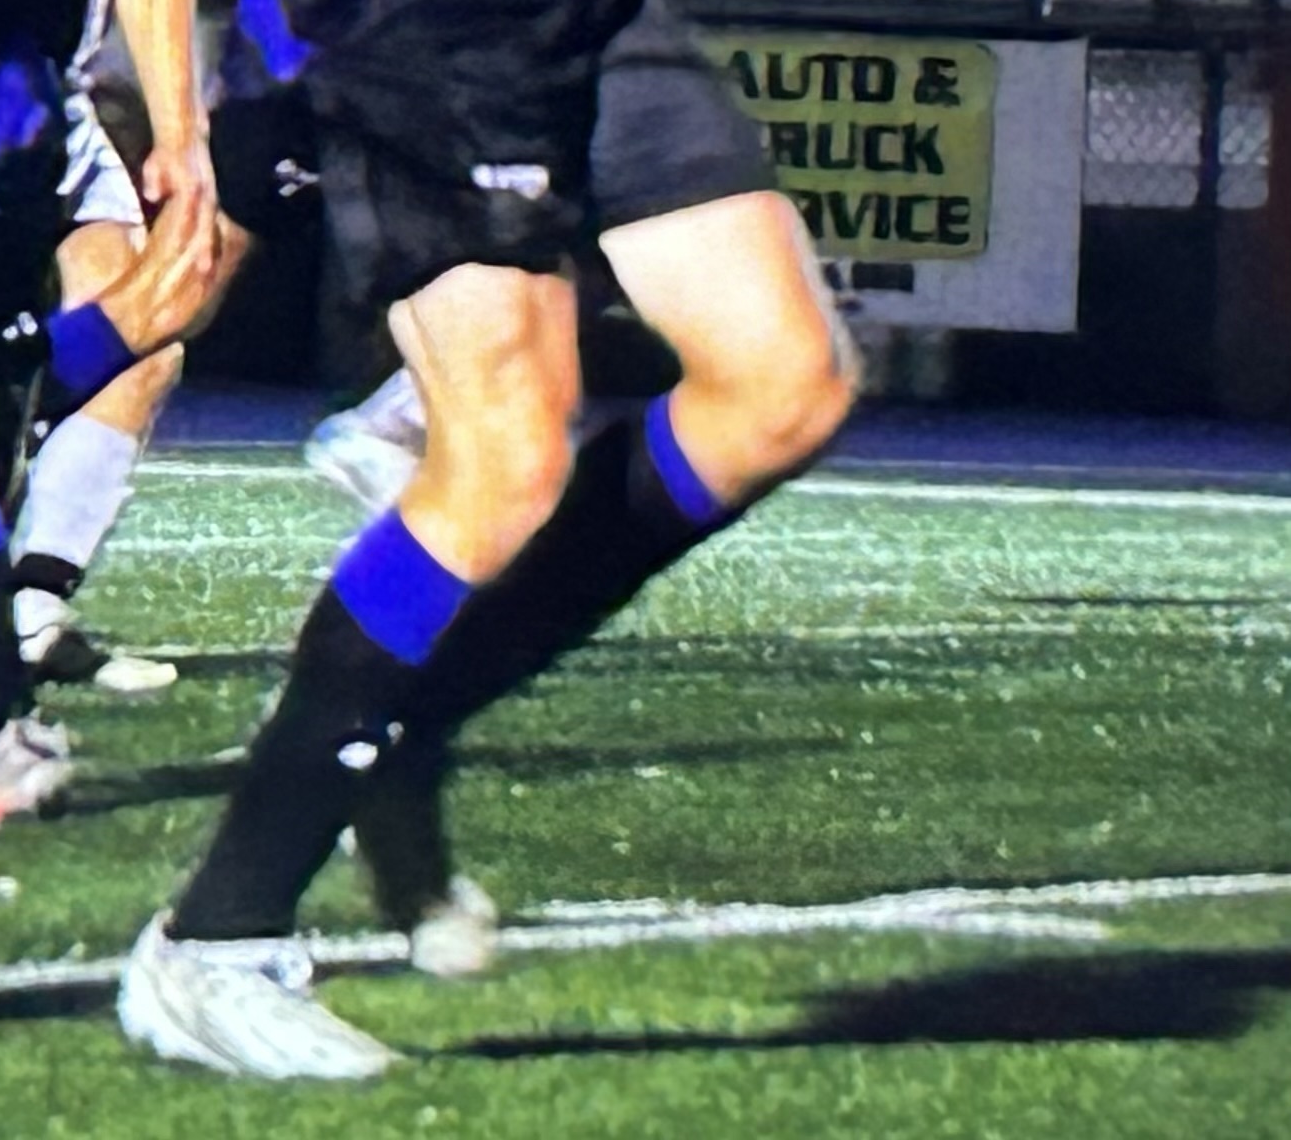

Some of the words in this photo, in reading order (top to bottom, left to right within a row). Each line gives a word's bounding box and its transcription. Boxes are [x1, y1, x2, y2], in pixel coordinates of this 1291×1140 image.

[729, 48, 898, 104] AUTO
[913, 57, 962, 107] &
[768, 121, 946, 176] RUCK
[787, 189, 972, 246] RVICE
